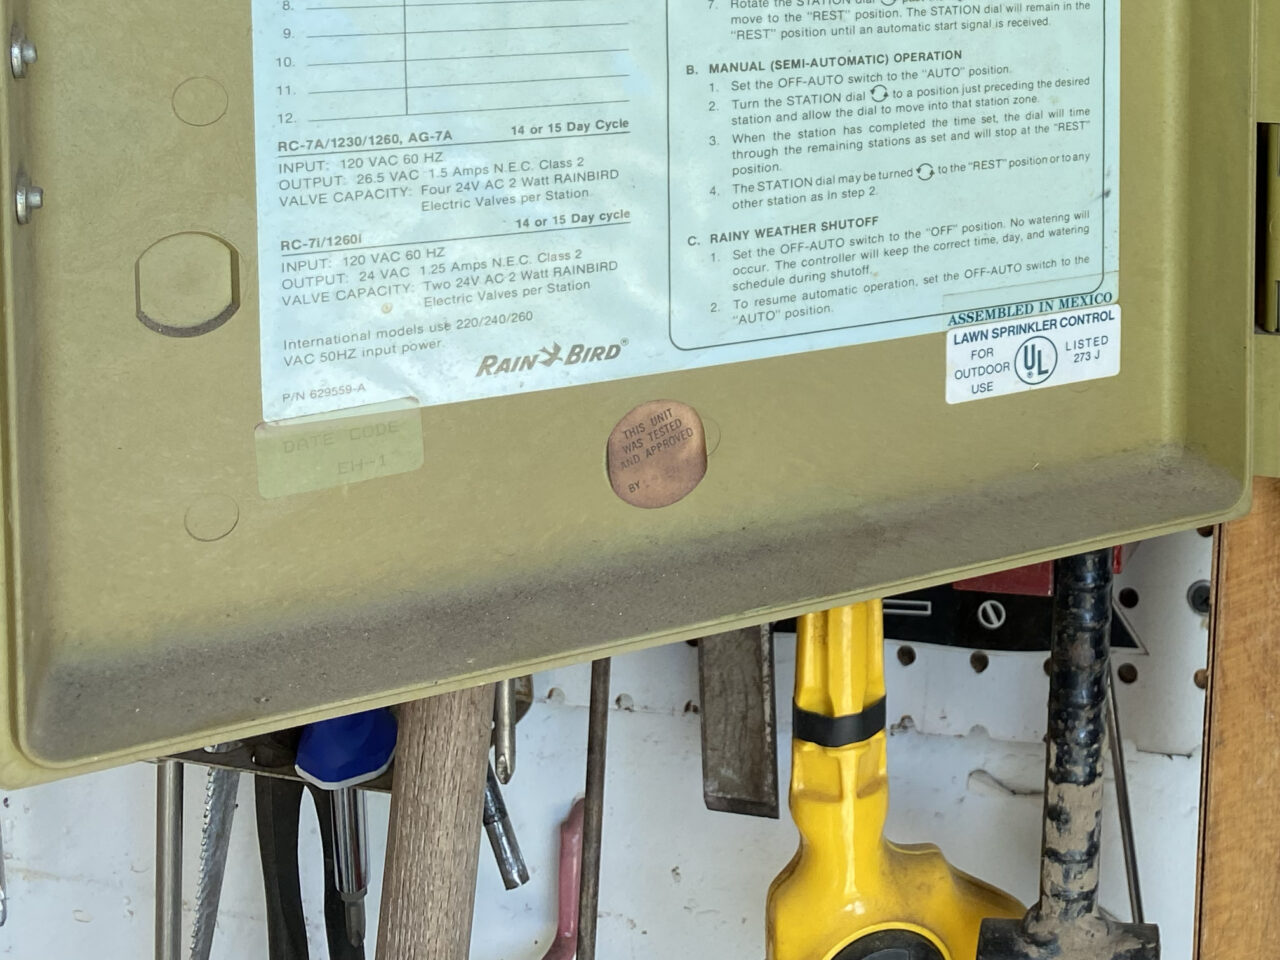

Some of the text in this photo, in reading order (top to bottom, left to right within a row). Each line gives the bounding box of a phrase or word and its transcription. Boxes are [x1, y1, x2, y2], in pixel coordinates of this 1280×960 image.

[685, 64, 698, 75] B.
[708, 49, 962, 74] MANUAL (SEMI-AUTOMATIC) OPERATION
[511, 118, 629, 135] 14 or 15 Day Cycle
[277, 129, 453, 152] RC-7A/1230/1260, AG-7A
[278, 151, 443, 174] INPUT: 120 VAC 60 HZ
[420, 168, 619, 195] Four 24V AC 2 Watt RAINBIRD
[278, 186, 411, 207] VALVE CAPACITY:
[421, 188, 589, 212] Electric Valves per Station
[687, 235, 700, 246] C.
[709, 215, 879, 244] RAINY WEATHER SHUTOFF
[948, 292, 1113, 326] ASSEMBLED IN MEXICO
[283, 310, 533, 351] International models use 220/240/260
[954, 310, 1115, 345] LAWN SPRINKLER CONTROL
[283, 339, 442, 367] VAC 50HZ input power.
[971, 348, 994, 360] FOR
[1065, 336, 1109, 351] LISTED
[475, 344, 622, 377] RAIN BIRD
[1074, 351, 1100, 363] 273 J
[954, 362, 1010, 380] OUTDOOR
[281, 382, 366, 403] P/N 629559-A
[972, 382, 993, 394] USE
[622, 418, 682, 454] WAS TESTED
[624, 408, 673, 440] THIS UNIT
[283, 421, 399, 454] DATE CODE
[621, 427, 693, 470] AND APPROVED
